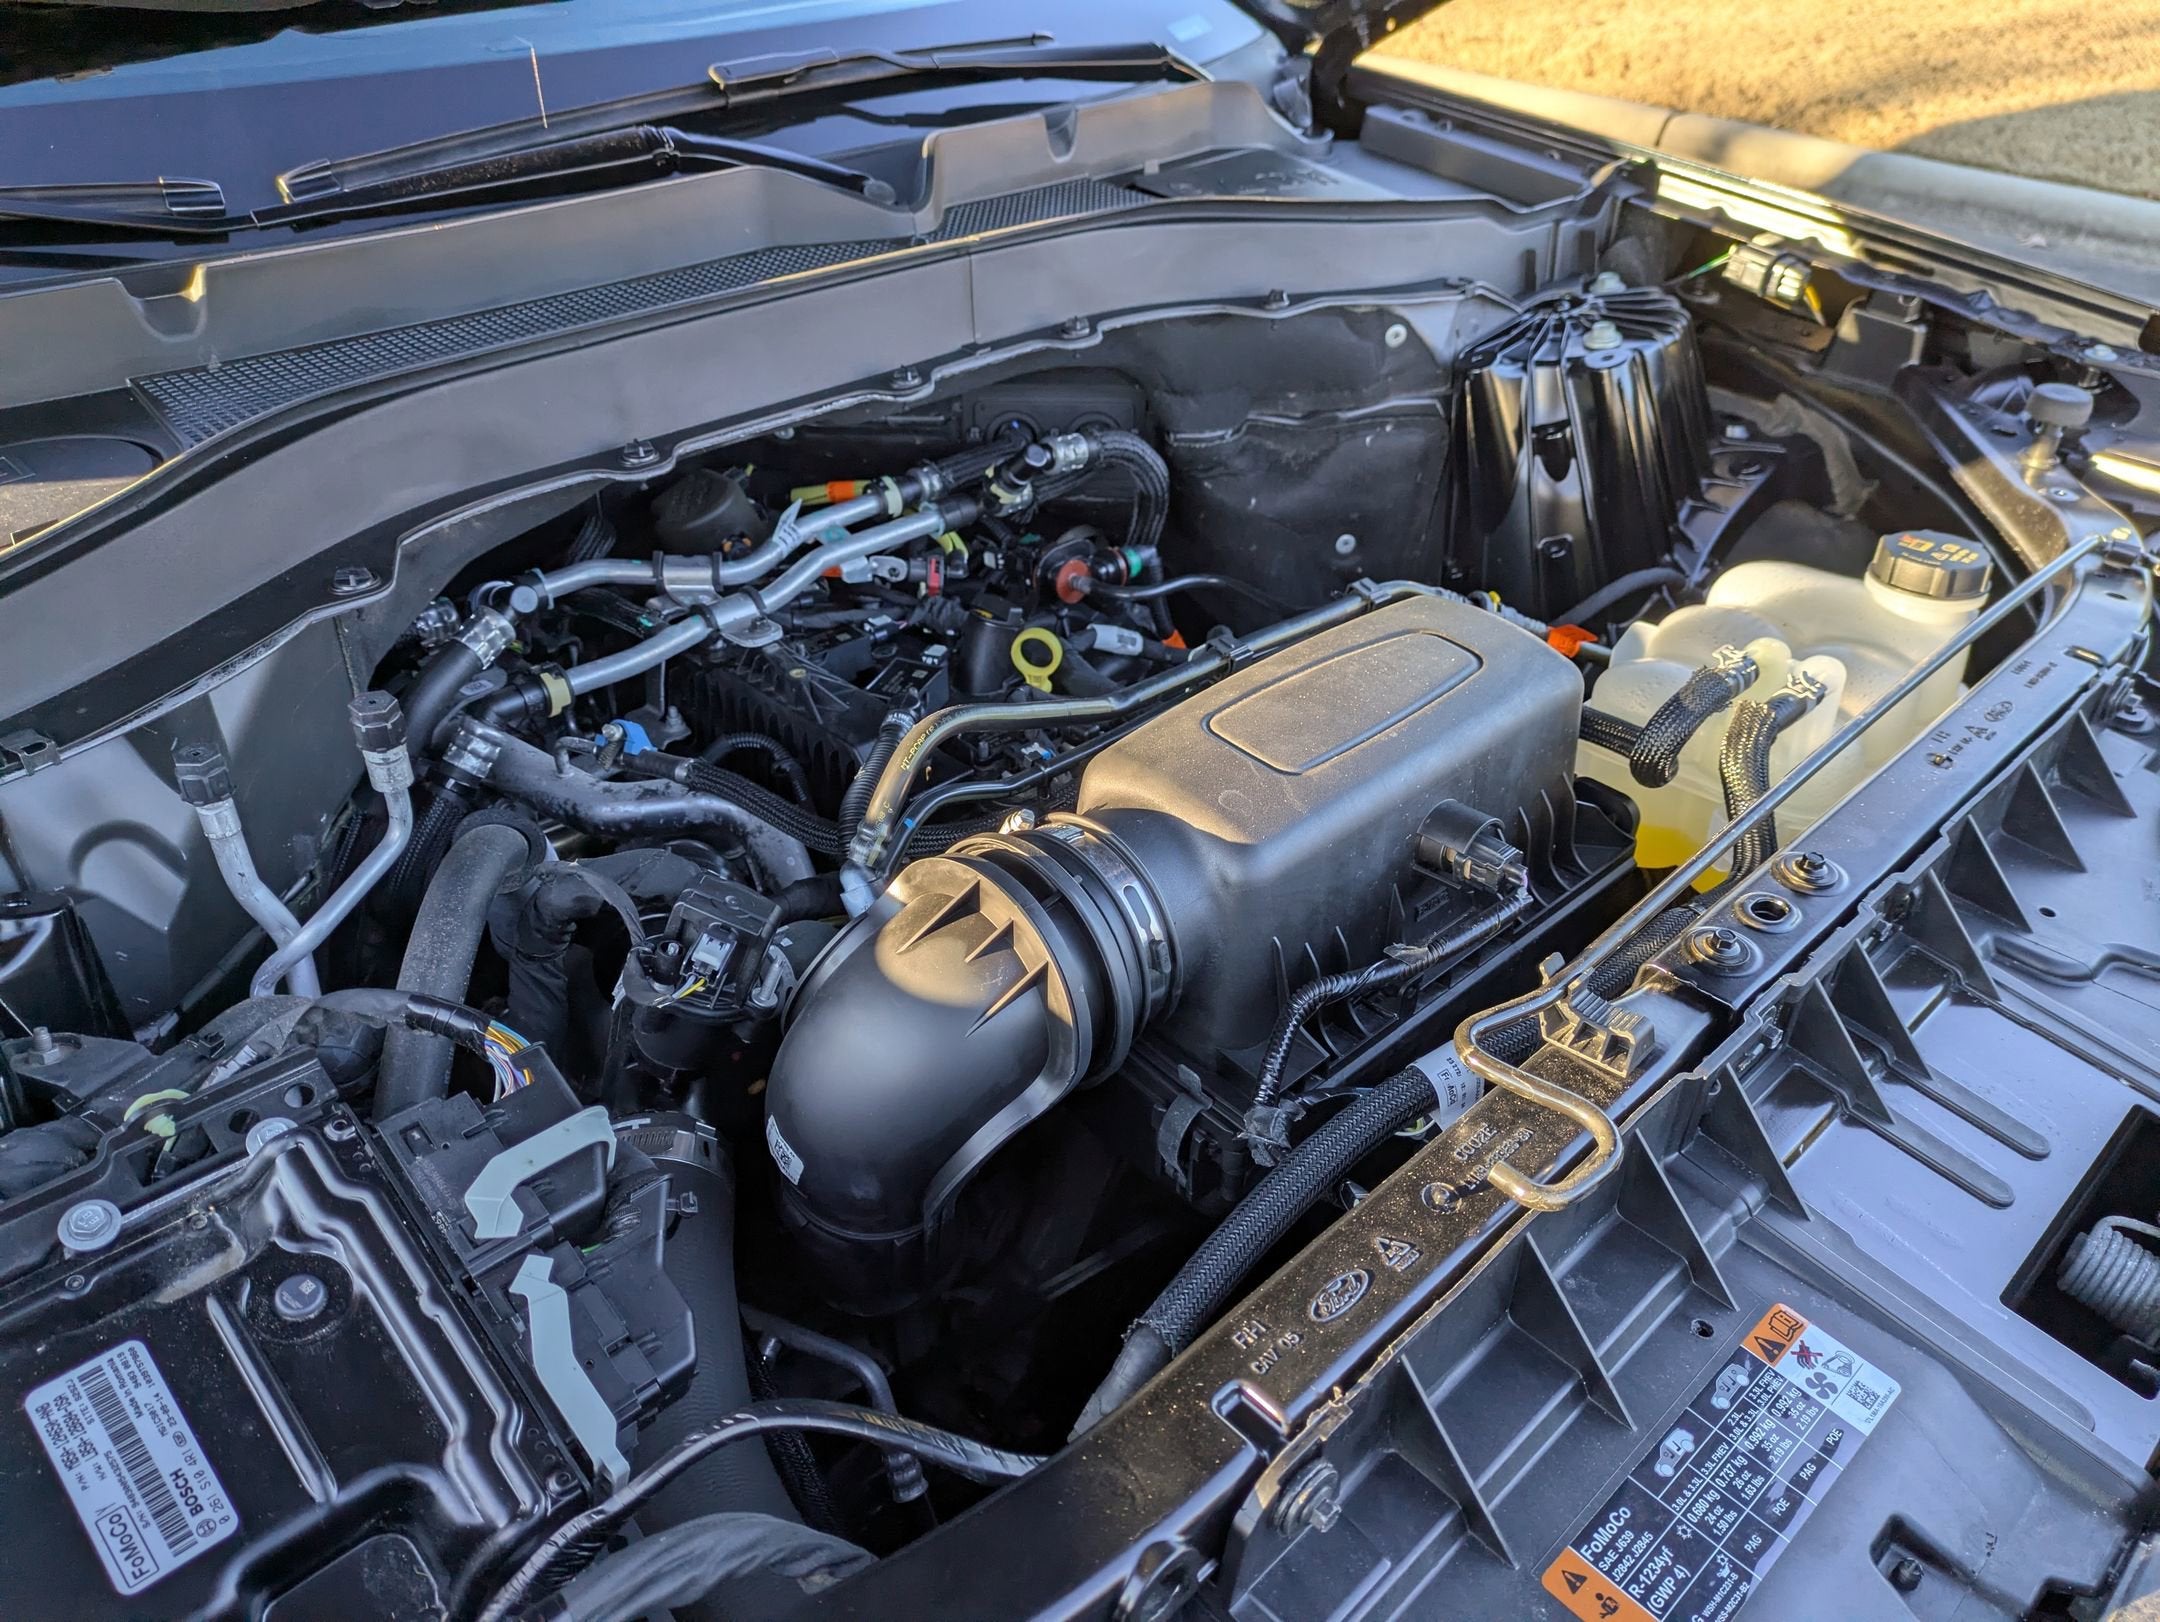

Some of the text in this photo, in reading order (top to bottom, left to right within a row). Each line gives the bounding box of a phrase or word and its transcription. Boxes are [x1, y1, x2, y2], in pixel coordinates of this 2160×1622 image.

[1315, 1272, 1364, 1319] Ford
[105, 1357, 127, 1390] Romania
[1748, 1368, 1776, 1399] 3.3L FHEV
[1756, 1375, 1784, 1406] 3.0L PHEV
[1770, 1385, 1802, 1418] 0.992 kg
[77, 1401, 95, 1425] SITE:
[126, 1396, 143, 1418] Made
[1726, 1408, 1744, 1426] 2.3L,
[1787, 1400, 1806, 1419] 35 oz
[1794, 1404, 1819, 1430] 2.19 lbs
[1728, 1406, 1758, 1440] 3.0L & 3.3L
[1743, 1416, 1776, 1450] 0.992 kg
[1825, 1427, 1842, 1446] POE
[1760, 1432, 1780, 1452] 35 oz
[1768, 1436, 1793, 1464] 2.19 lbs
[1700, 1441, 1730, 1475] 3.3L FHEV
[1714, 1452, 1748, 1488] 0.737 kg
[1798, 1461, 1817, 1480] PAG
[73, 1470, 89, 1491] P/N:
[168, 1466, 204, 1517] BOSCH
[1670, 1474, 1703, 1511] 3.0L & 3.3L
[1731, 1469, 1751, 1489] 26 oz
[1740, 1472, 1765, 1501] 1.63 lbs
[205, 1491, 224, 1514] 261
[1686, 1486, 1721, 1523] 0.680 kg
[1703, 1504, 1724, 1525] 24 oz
[1772, 1496, 1790, 1516] POE
[134, 1508, 150, 1529] S/N:
[1579, 1502, 1632, 1561] FoMoCo
[1712, 1508, 1738, 1537] 1.50 lbs
[103, 1511, 150, 1580] FoMoCo
[1597, 1528, 1635, 1572] SAE J639
[1609, 1530, 1654, 1582] J2842 J2845
[1743, 1533, 1762, 1554] PAG
[1627, 1544, 1677, 1602] R-1234yf
[1645, 1562, 1692, 1616] (GWP 4)
[1701, 1571, 1739, 1618] WSH-M1C231-B
